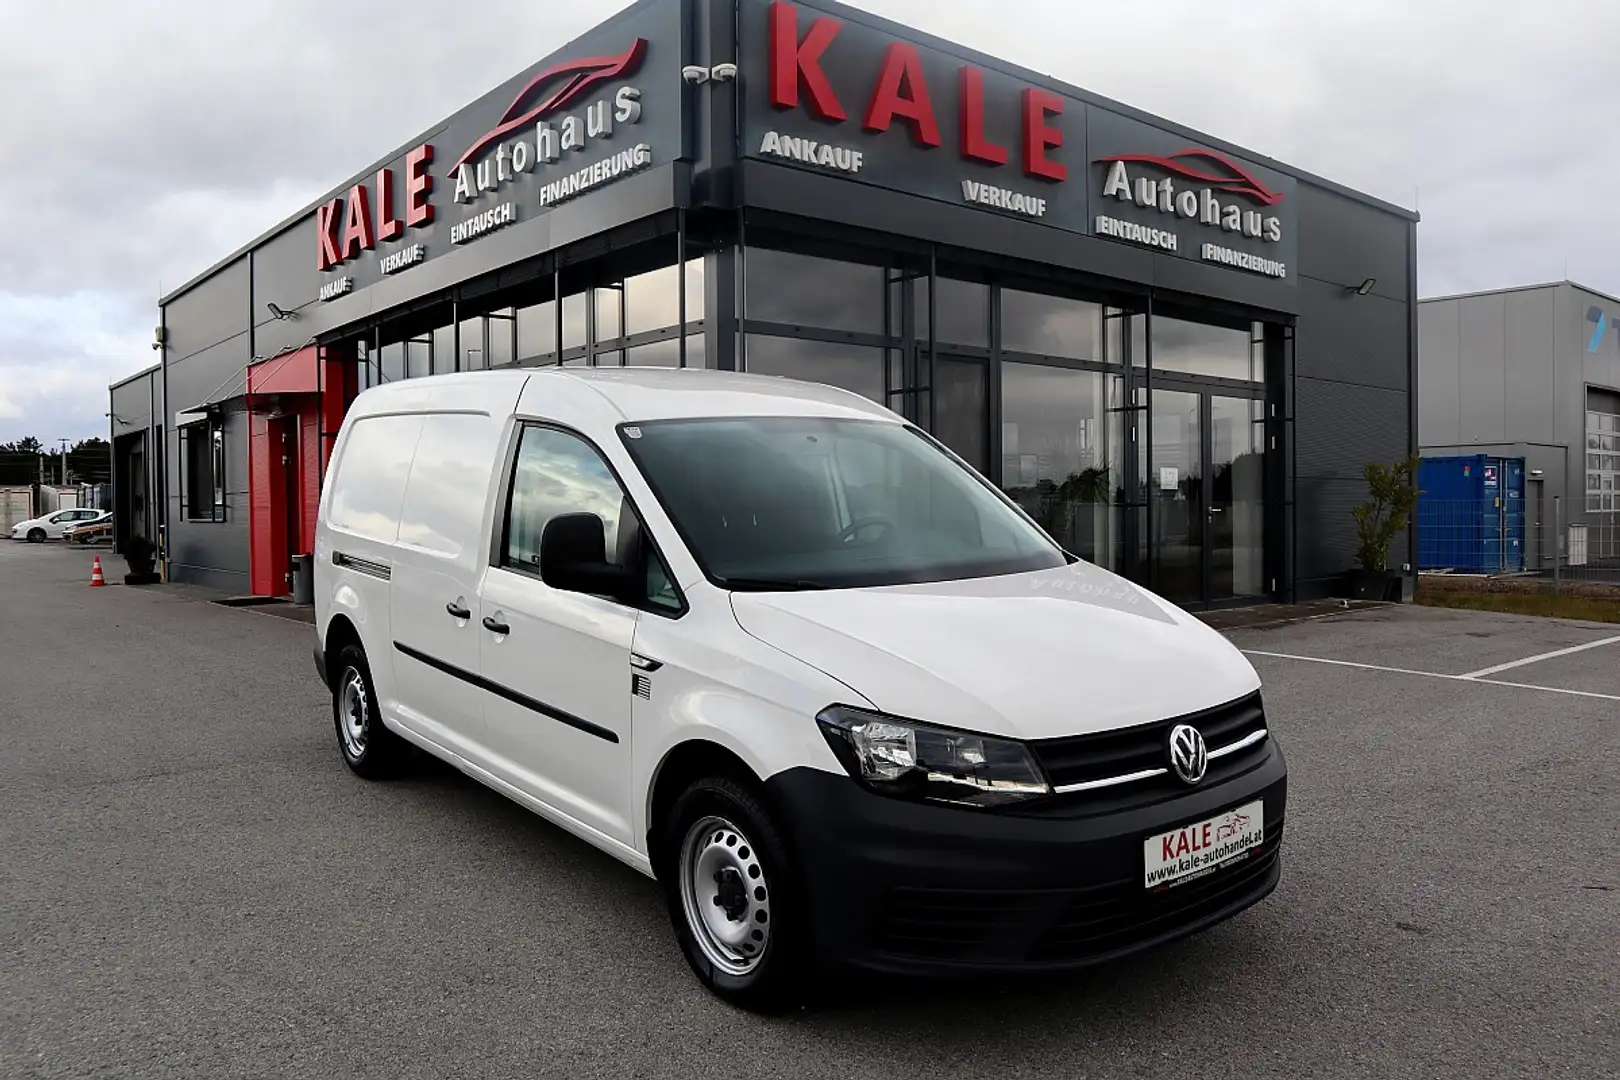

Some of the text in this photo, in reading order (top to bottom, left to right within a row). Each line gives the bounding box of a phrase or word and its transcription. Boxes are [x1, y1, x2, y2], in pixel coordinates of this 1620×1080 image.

[454, 86, 643, 203] Autohaus
[770, 1, 1067, 182] KALE
[316, 144, 434, 272] KALE
[318, 143, 651, 302] ANKAUF VERKAUF EINTAUSCH FINANZIERUNG
[760, 131, 1286, 279] ANKAUF VERKAUF EINTAUSCH FINANZIERUNG
[1103, 161, 1280, 243] Autohaus
[1147, 829, 1262, 883] www.kale-autohandel.at
[1162, 822, 1212, 862] KALE
